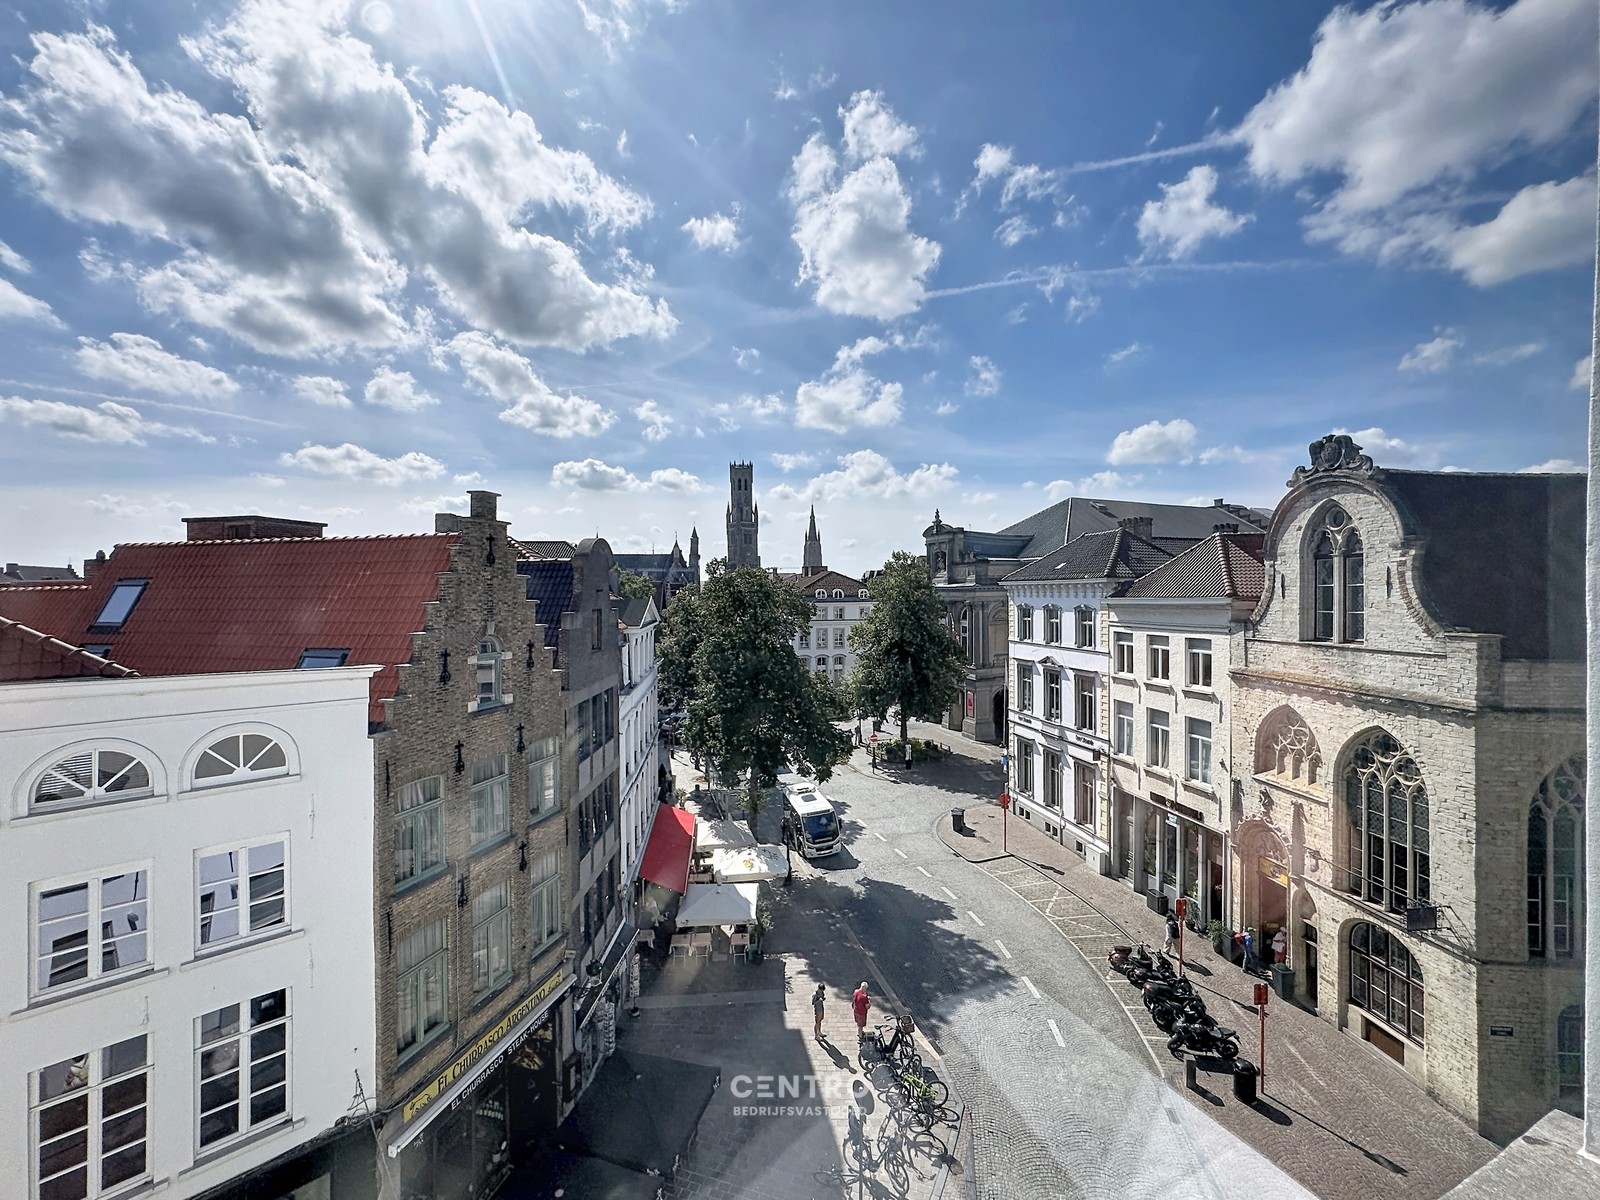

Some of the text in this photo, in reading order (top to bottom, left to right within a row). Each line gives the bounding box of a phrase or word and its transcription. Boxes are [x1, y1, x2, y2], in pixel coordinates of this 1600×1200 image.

[451, 1011, 549, 1110] EL CHURRASCO STEAK-HOUSE
[452, 1026, 504, 1079] CHURRASCO
[506, 988, 546, 1030] ARGENTINO
